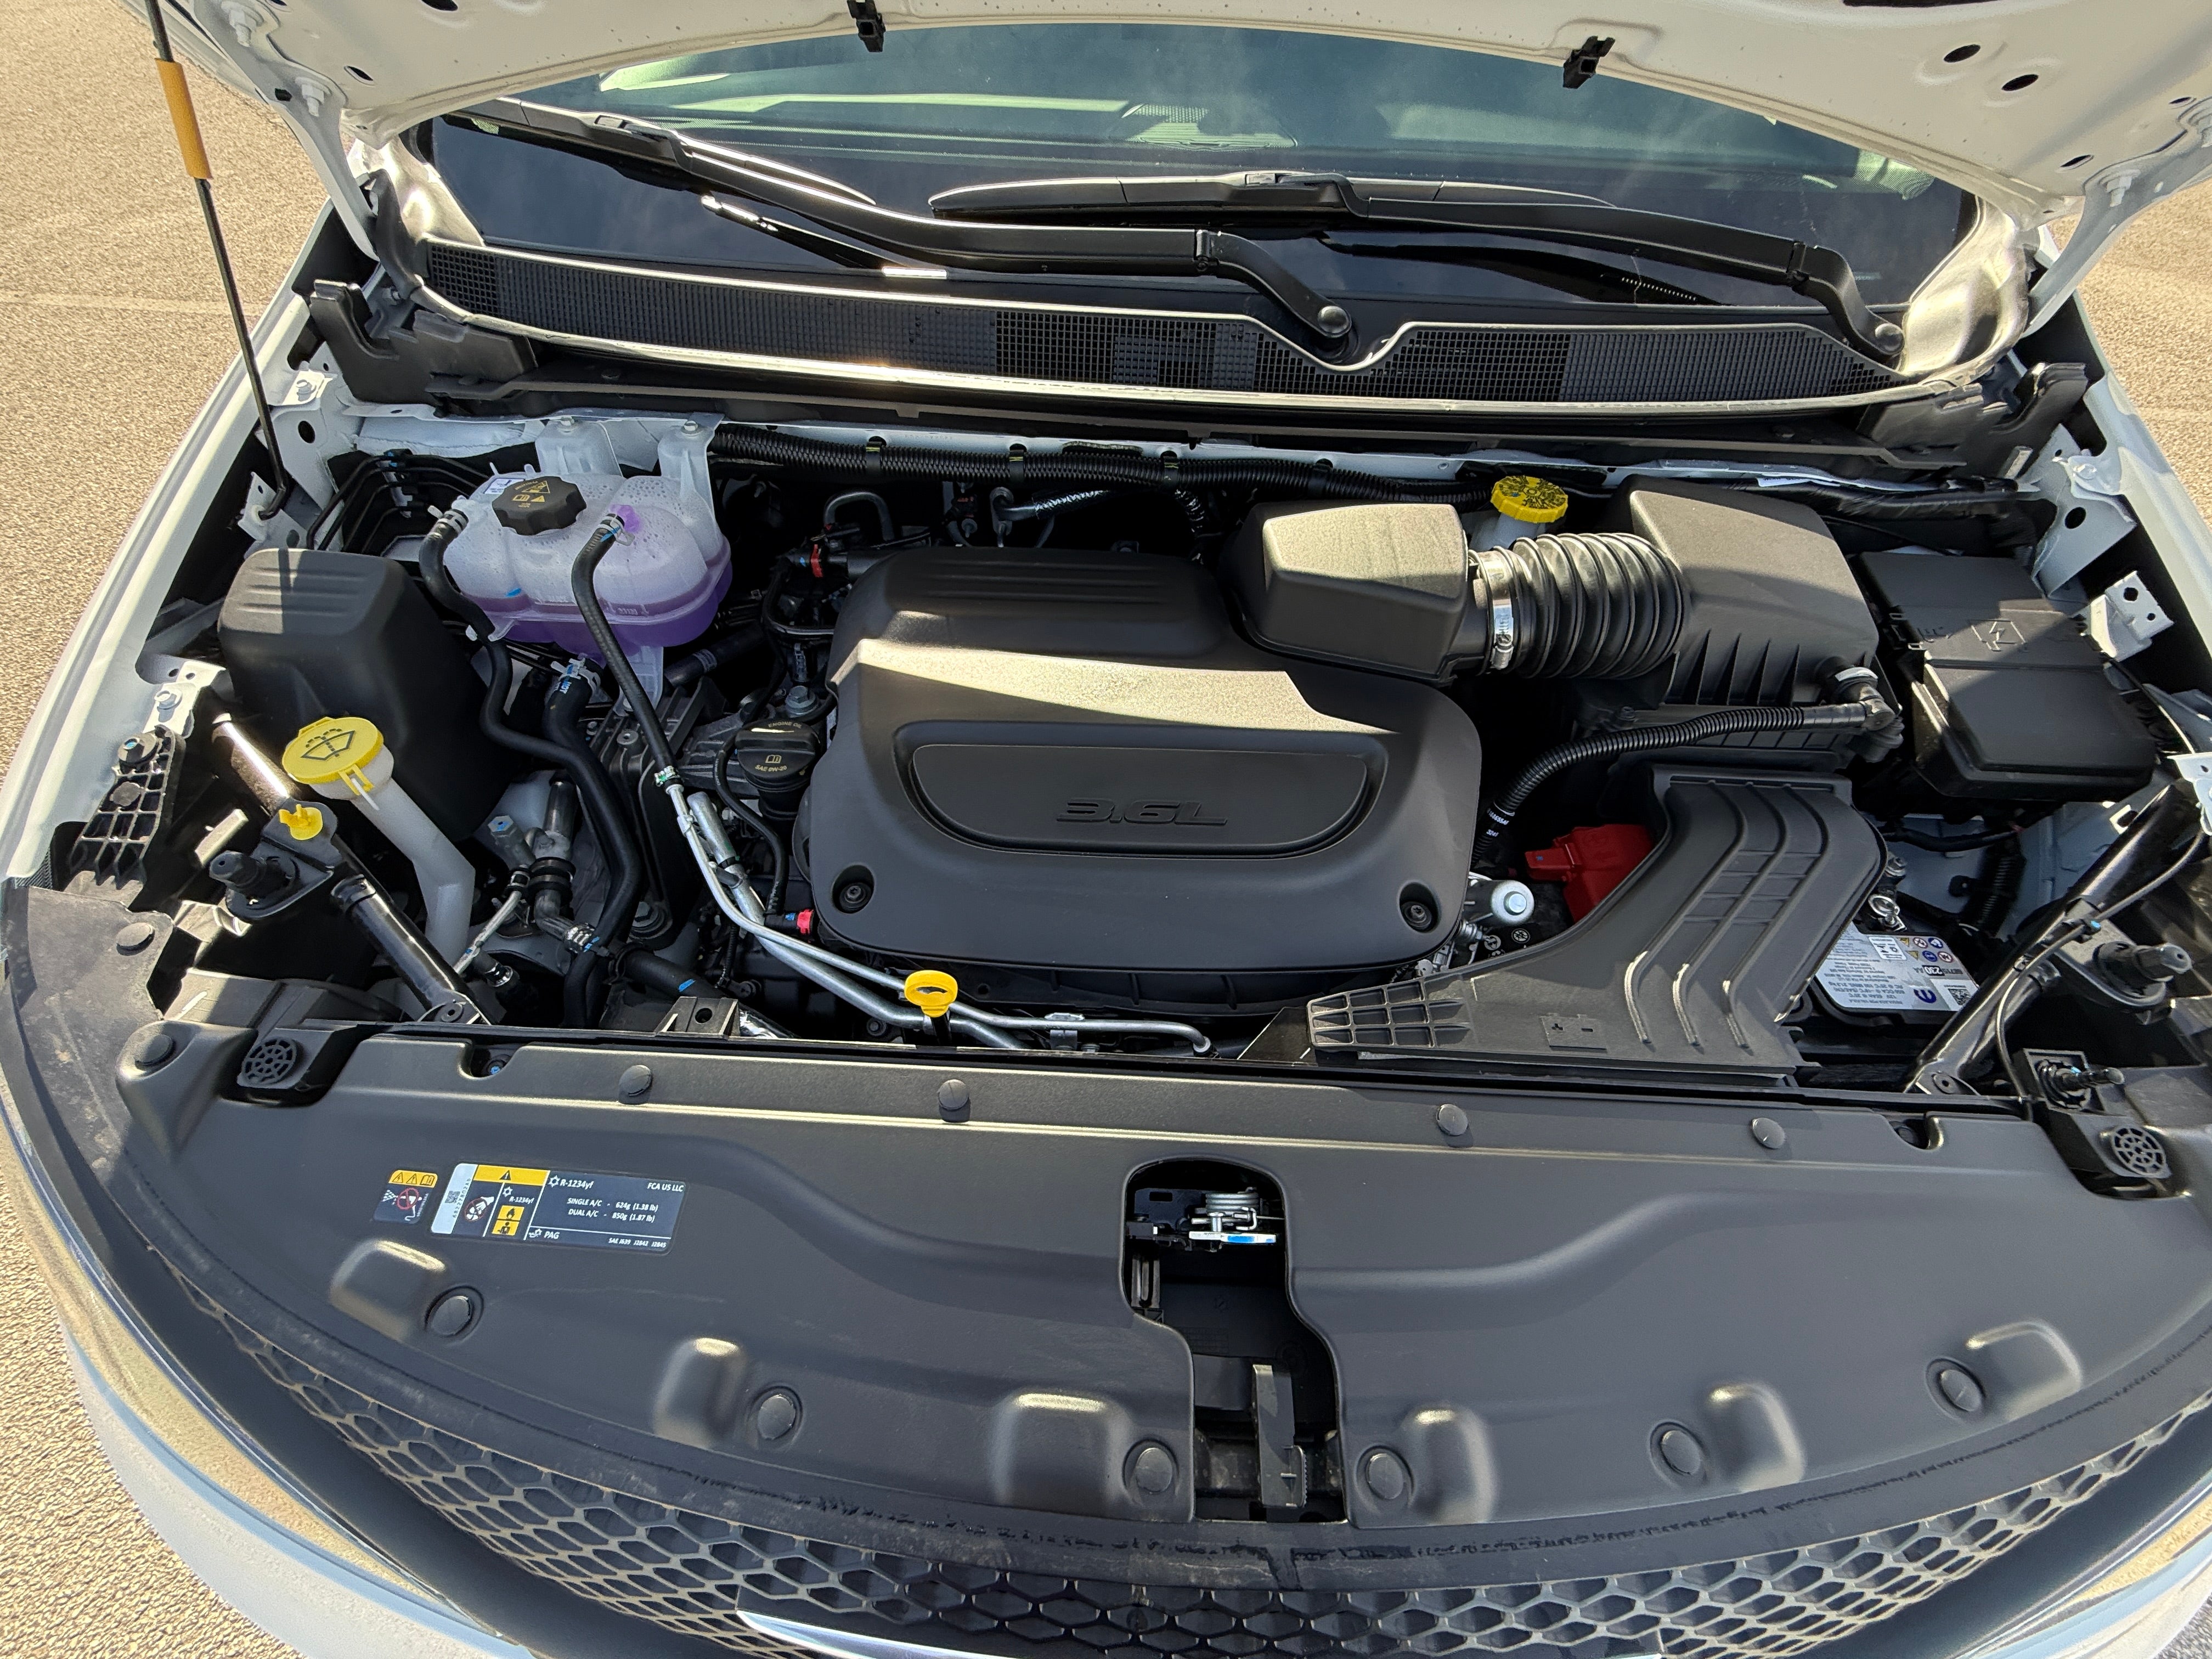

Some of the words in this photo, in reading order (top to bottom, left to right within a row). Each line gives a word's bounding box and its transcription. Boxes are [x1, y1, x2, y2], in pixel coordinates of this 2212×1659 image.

[1057, 798, 1227, 826] 3.6L
[560, 1179, 594, 1190] R-1234yf
[509, 1196, 535, 1205] R-1234yf
[567, 1197, 589, 1206] SINGLE
[589, 1199, 603, 1207] A/C
[615, 1201, 631, 1210] 624g
[633, 1203, 650, 1211] (1.38
[649, 1204, 658, 1212] lb)
[612, 1212, 628, 1221] 850g
[629, 1213, 646, 1222] (1.87
[646, 1214, 656, 1223] lb)
[544, 1231, 560, 1239] PAG
